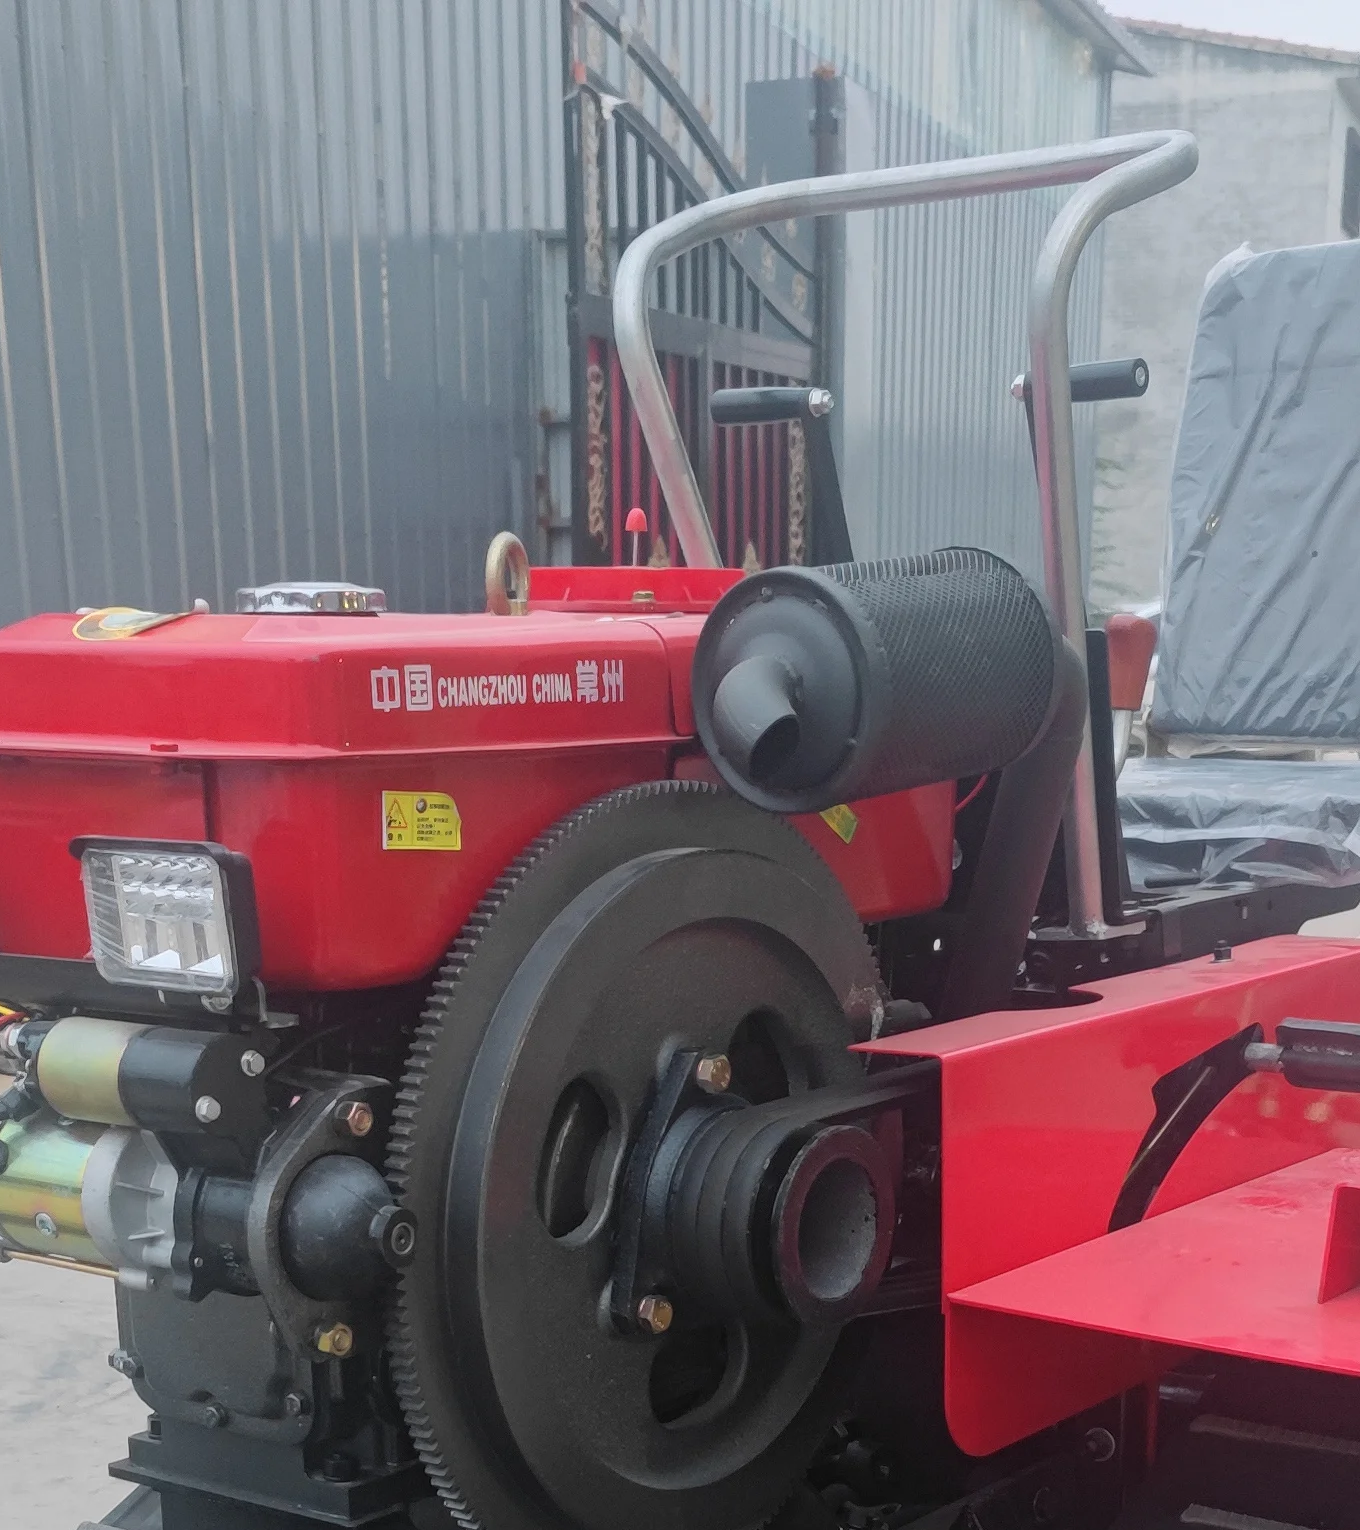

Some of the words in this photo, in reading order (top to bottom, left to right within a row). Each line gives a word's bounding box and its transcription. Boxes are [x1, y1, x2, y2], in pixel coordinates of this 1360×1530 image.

[370, 664, 433, 713] 中国
[437, 674, 527, 708] CHANGZHOU
[532, 673, 572, 704] CHINA
[576, 659, 624, 704] 常州
